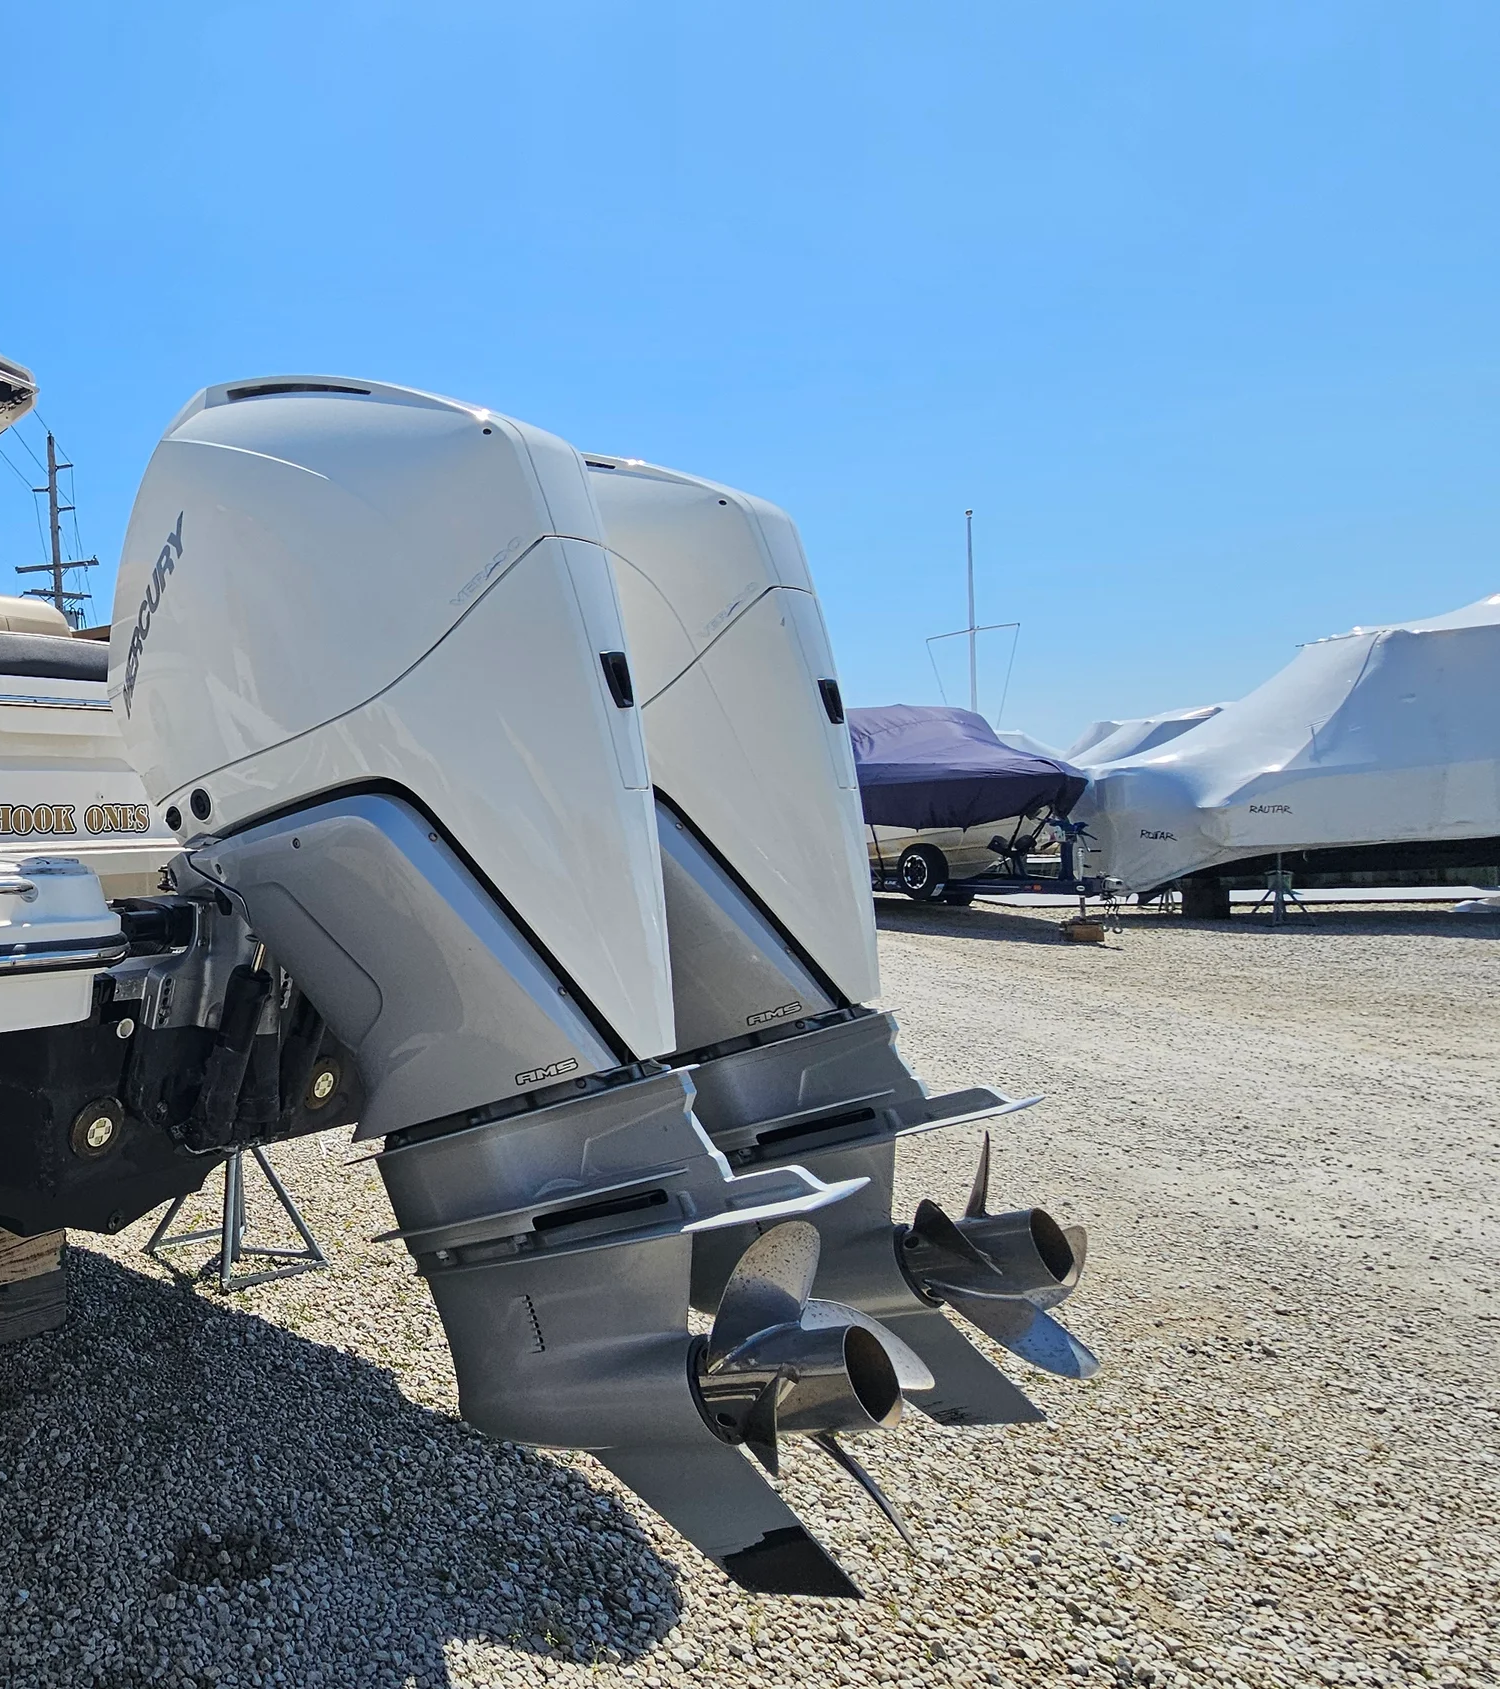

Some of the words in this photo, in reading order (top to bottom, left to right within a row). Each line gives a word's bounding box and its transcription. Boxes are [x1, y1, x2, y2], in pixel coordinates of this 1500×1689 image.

[123, 511, 184, 720] MERCURY
[84, 803, 150, 833] ONES
[747, 1002, 802, 1026] AMS
[515, 1058, 578, 1085] AMS
